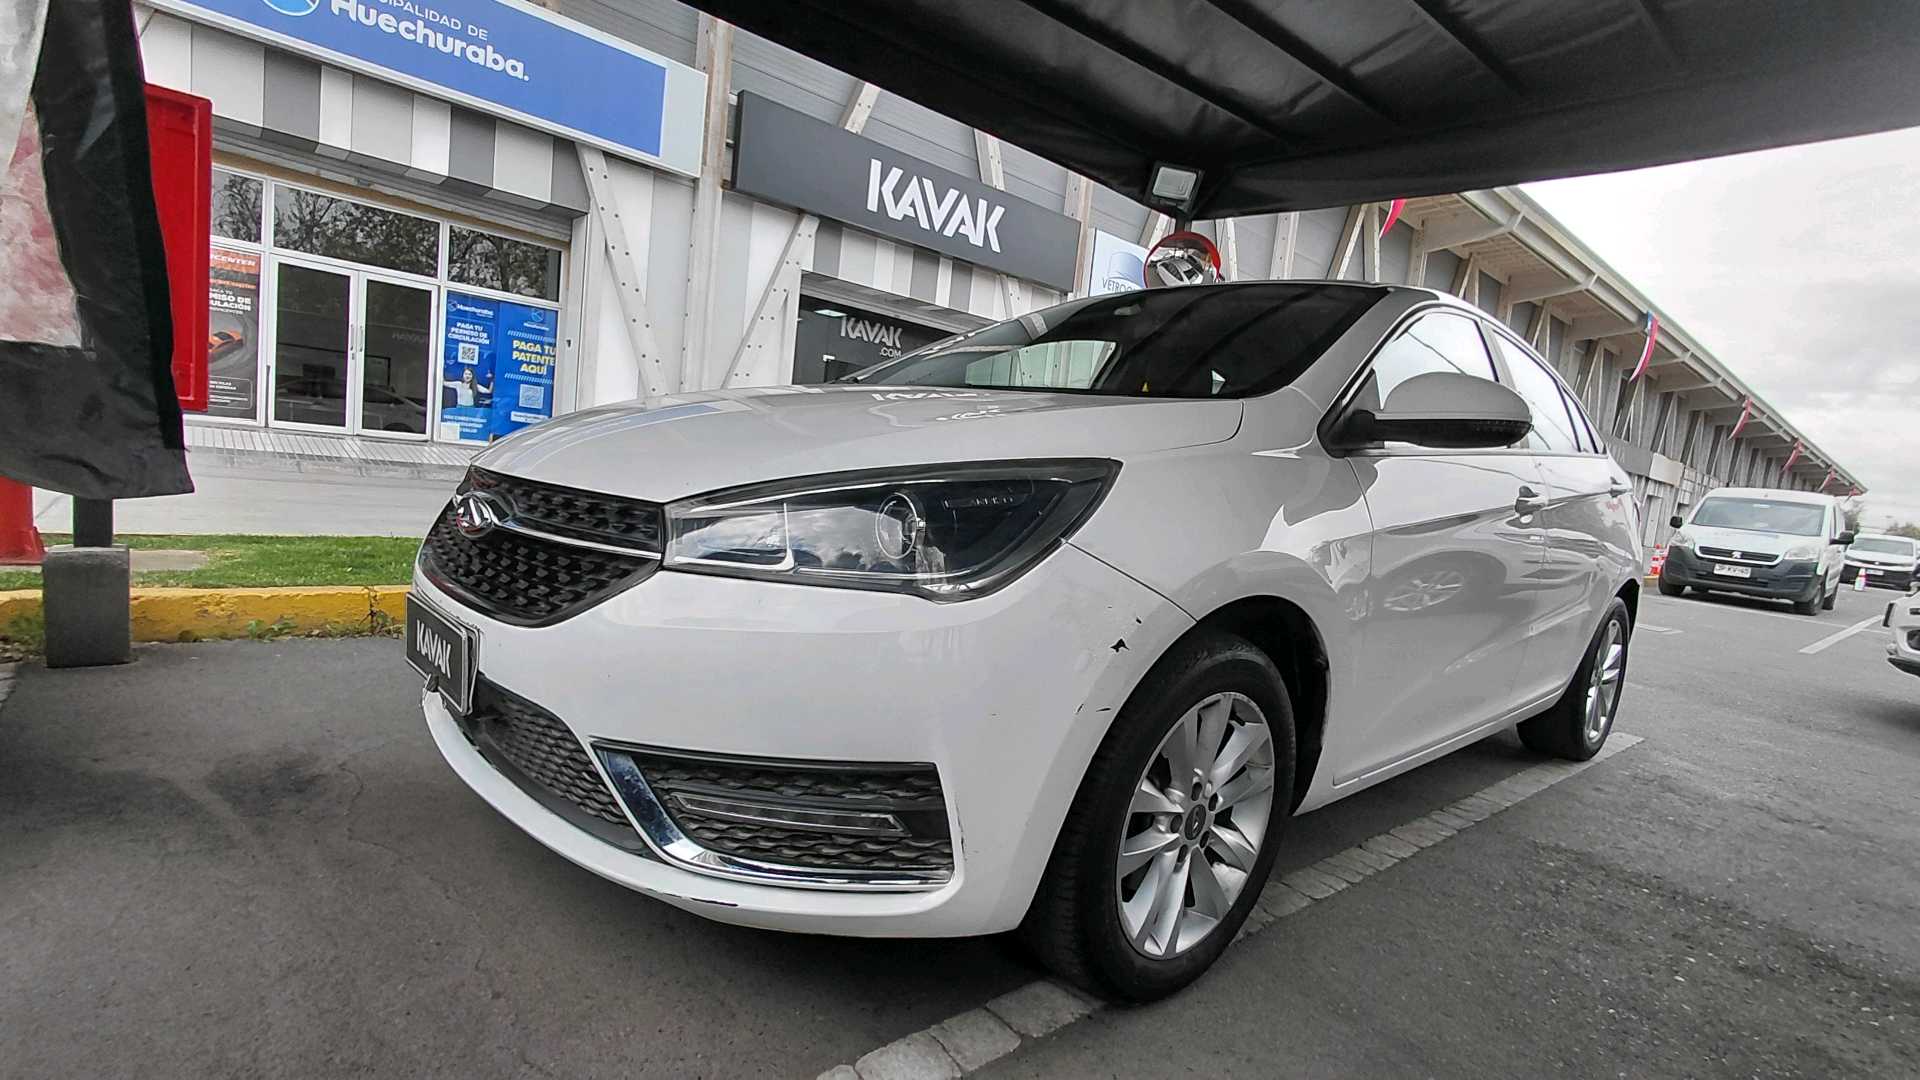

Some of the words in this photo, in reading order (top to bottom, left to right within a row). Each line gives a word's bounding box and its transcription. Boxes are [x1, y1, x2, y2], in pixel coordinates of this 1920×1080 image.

[467, 24, 488, 41] DE
[330, 0, 530, 82] Huechuraba.
[866, 158, 1005, 254] KAVAK
[209, 300, 252, 311] ULACIÓN
[237, 296, 252, 305] DE
[450, 327, 479, 337] PERMISO
[456, 321, 474, 330] PAGA
[840, 316, 903, 349] KAVAK
[512, 339, 542, 353] PAGA
[543, 345, 556, 355] TU
[511, 350, 556, 366] PATENTE
[415, 618, 451, 679] KAVAK
